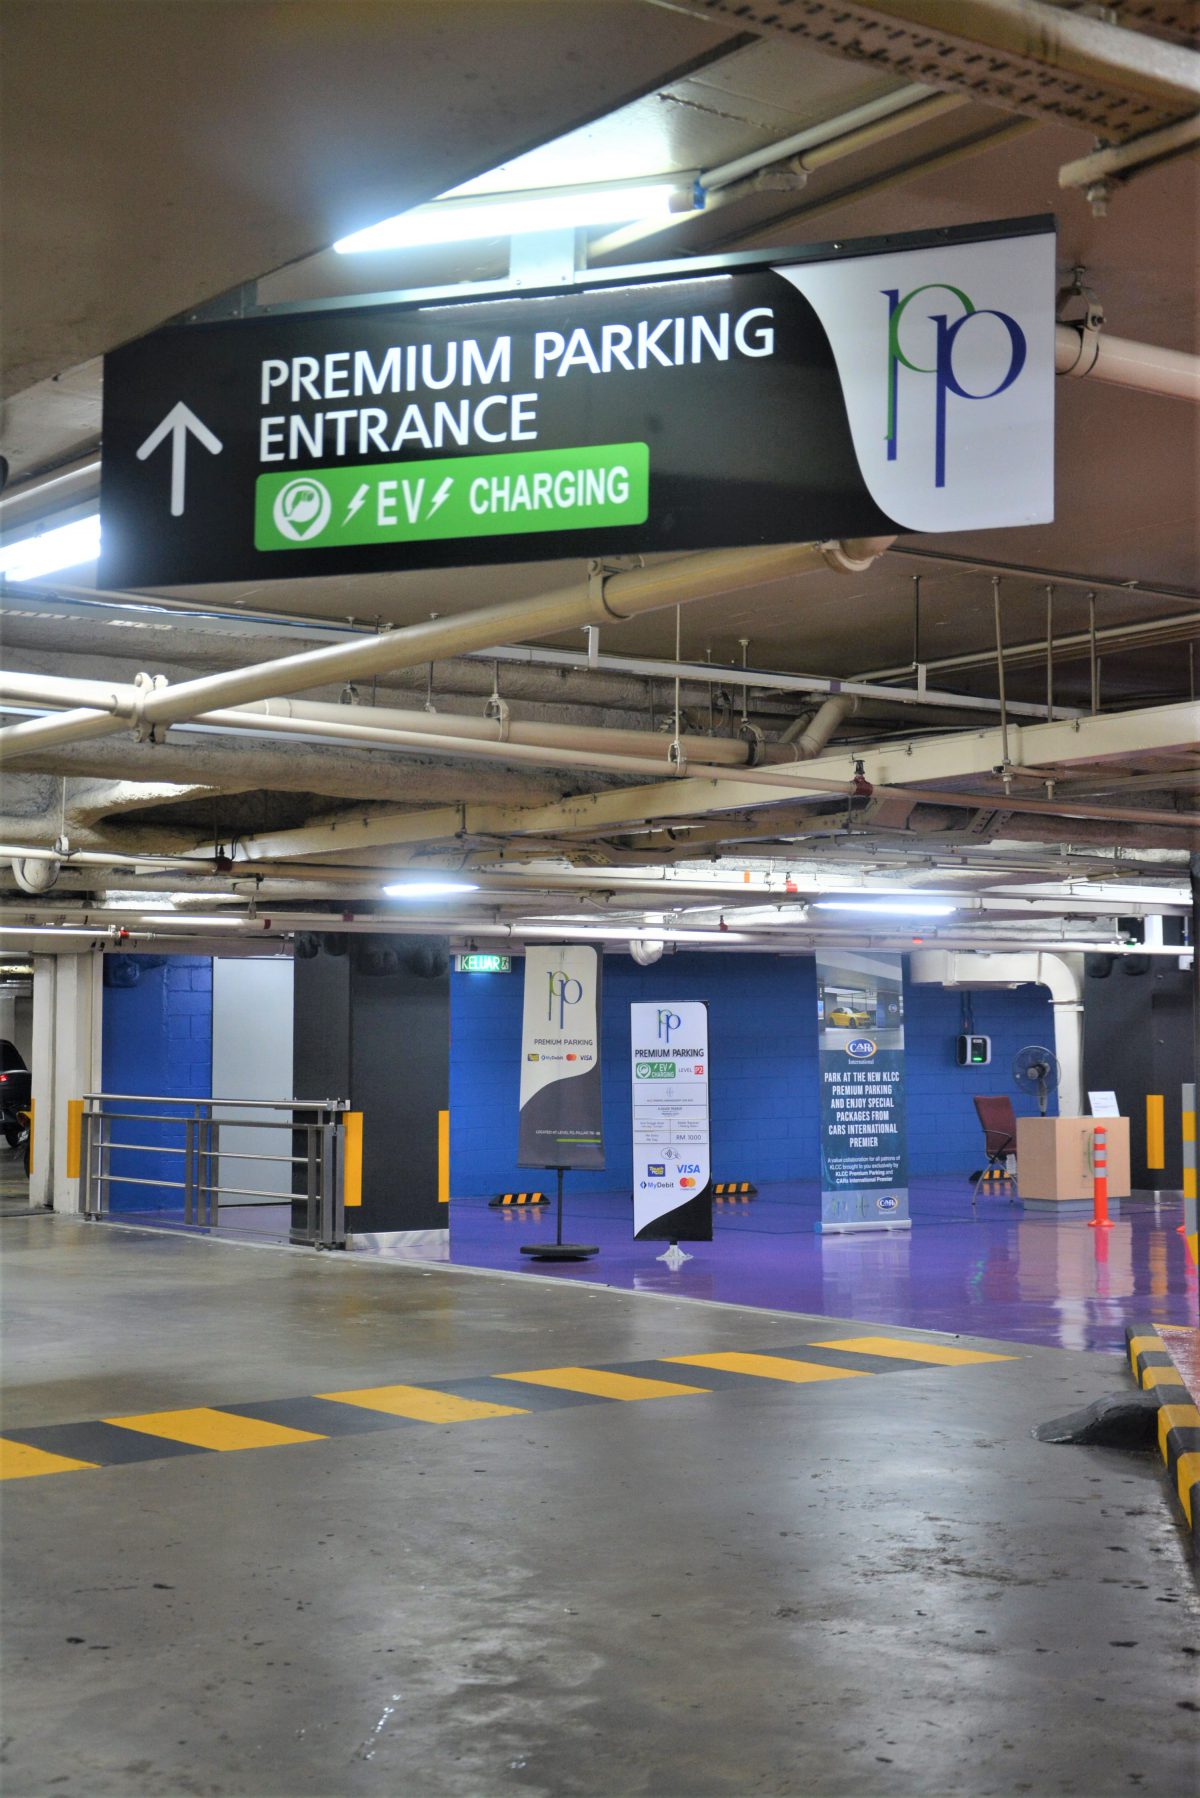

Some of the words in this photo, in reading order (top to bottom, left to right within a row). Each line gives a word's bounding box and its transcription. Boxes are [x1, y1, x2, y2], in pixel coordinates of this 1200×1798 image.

[261, 335, 511, 405] PREMIUM
[534, 307, 775, 380] PARKING
[259, 393, 539, 463] ENTRANCE
[377, 477, 426, 527] EV
[469, 466, 629, 515] CHARGING
[461, 955, 501, 970] KELUAR
[634, 1049, 670, 1057] PREMIUM
[672, 1048, 704, 1057] PARKING
[660, 1064, 668, 1072] EV
[824, 1072, 841, 1082] PARK
[843, 1072, 851, 1082] AT
[853, 1072, 866, 1082] THE
[867, 1072, 881, 1081] NEW
[882, 1071, 900, 1081] KLCC
[832, 1085, 863, 1095] PREMIUM
[865, 1084, 893, 1095] PARKING
[830, 1098, 845, 1108] AND
[846, 1098, 866, 1108] ENJOY
[867, 1097, 894, 1107] SPECIAL
[836, 1111, 870, 1121] PACKAGES
[871, 1110, 889, 1120] FROM
[828, 1124, 846, 1135] CARS
[848, 1123, 898, 1134] INTERNATIONAL
[849, 1136, 878, 1147] PREMIER
[677, 1164, 700, 1173] VISA
[647, 1181, 674, 1189] MyDebit
